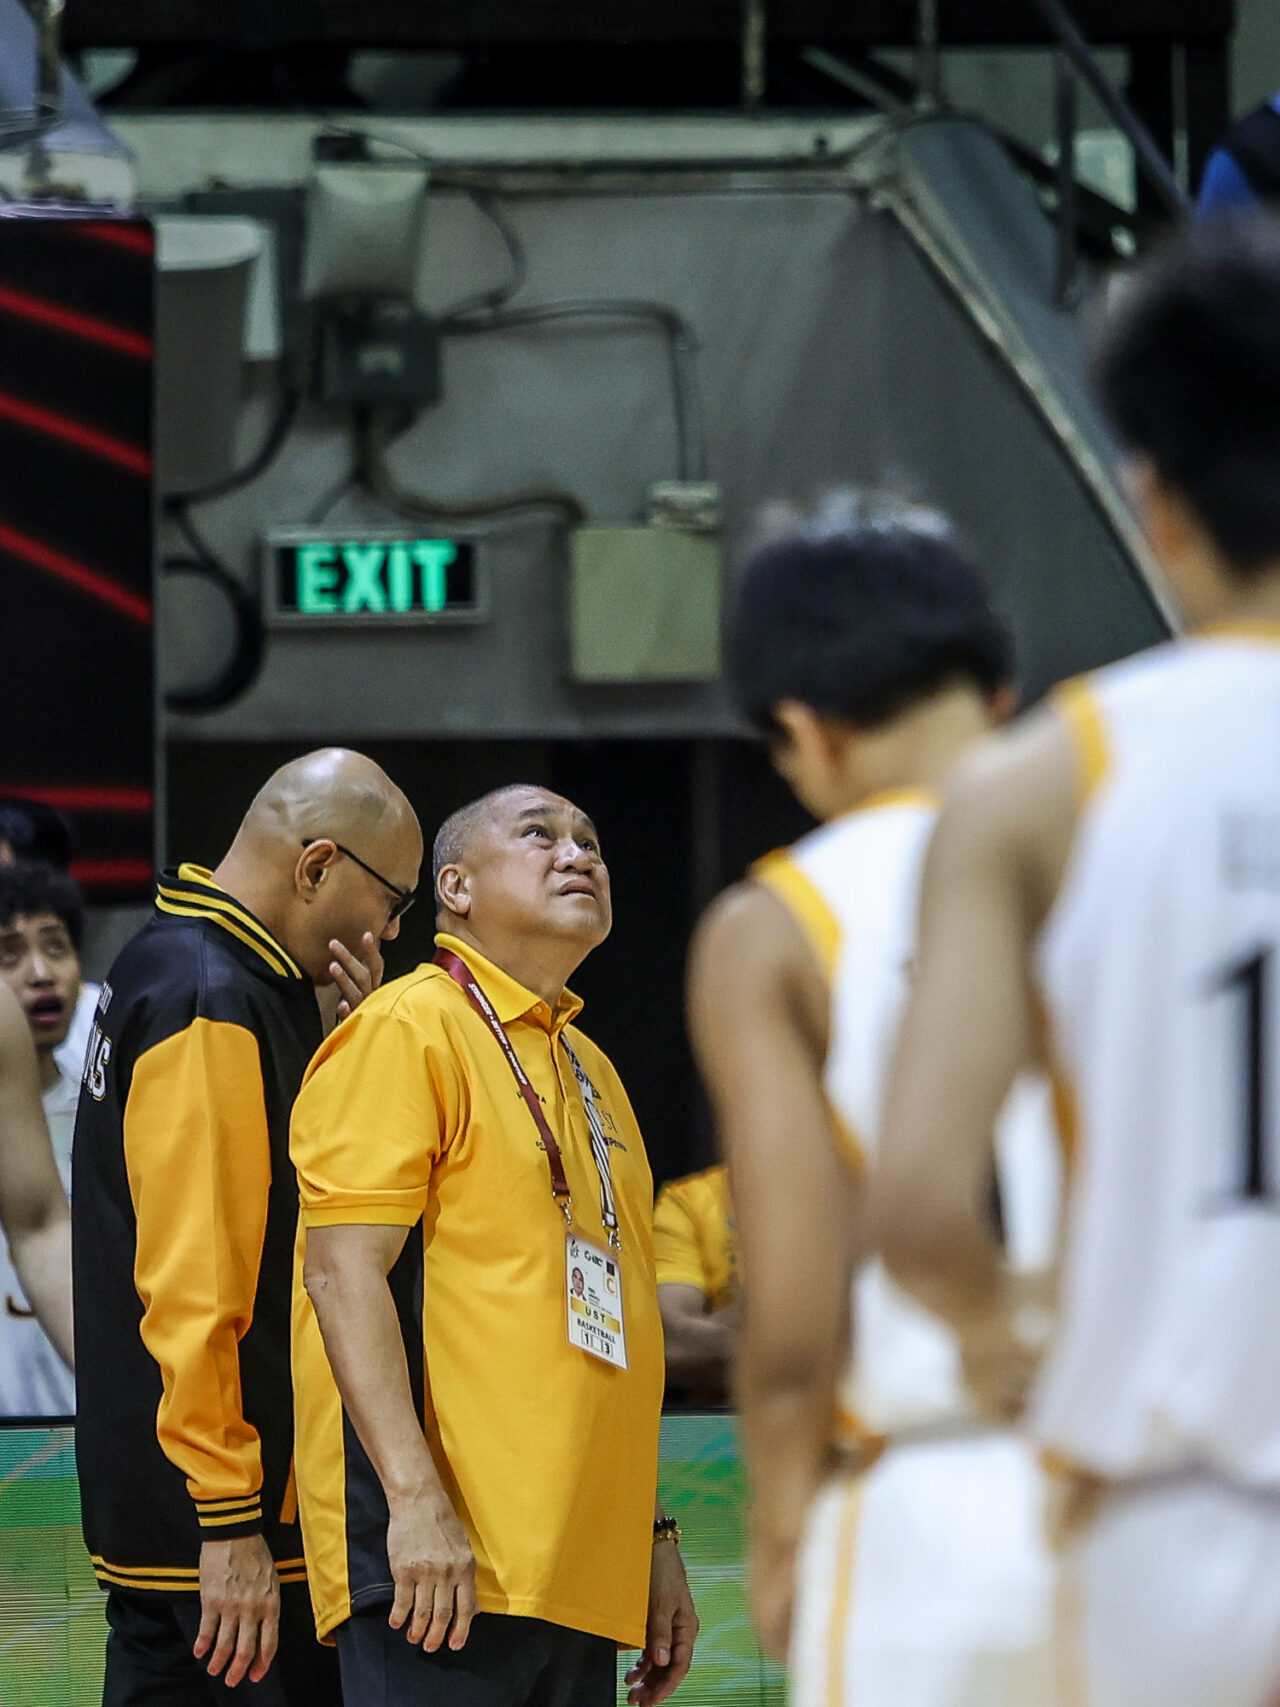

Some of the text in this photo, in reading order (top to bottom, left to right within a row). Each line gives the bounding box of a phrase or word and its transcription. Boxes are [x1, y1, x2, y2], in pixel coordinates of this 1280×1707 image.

[297, 540, 458, 613] EXIT
[585, 1305, 606, 1324] UST
[577, 1318, 616, 1344] BASKETBALL
